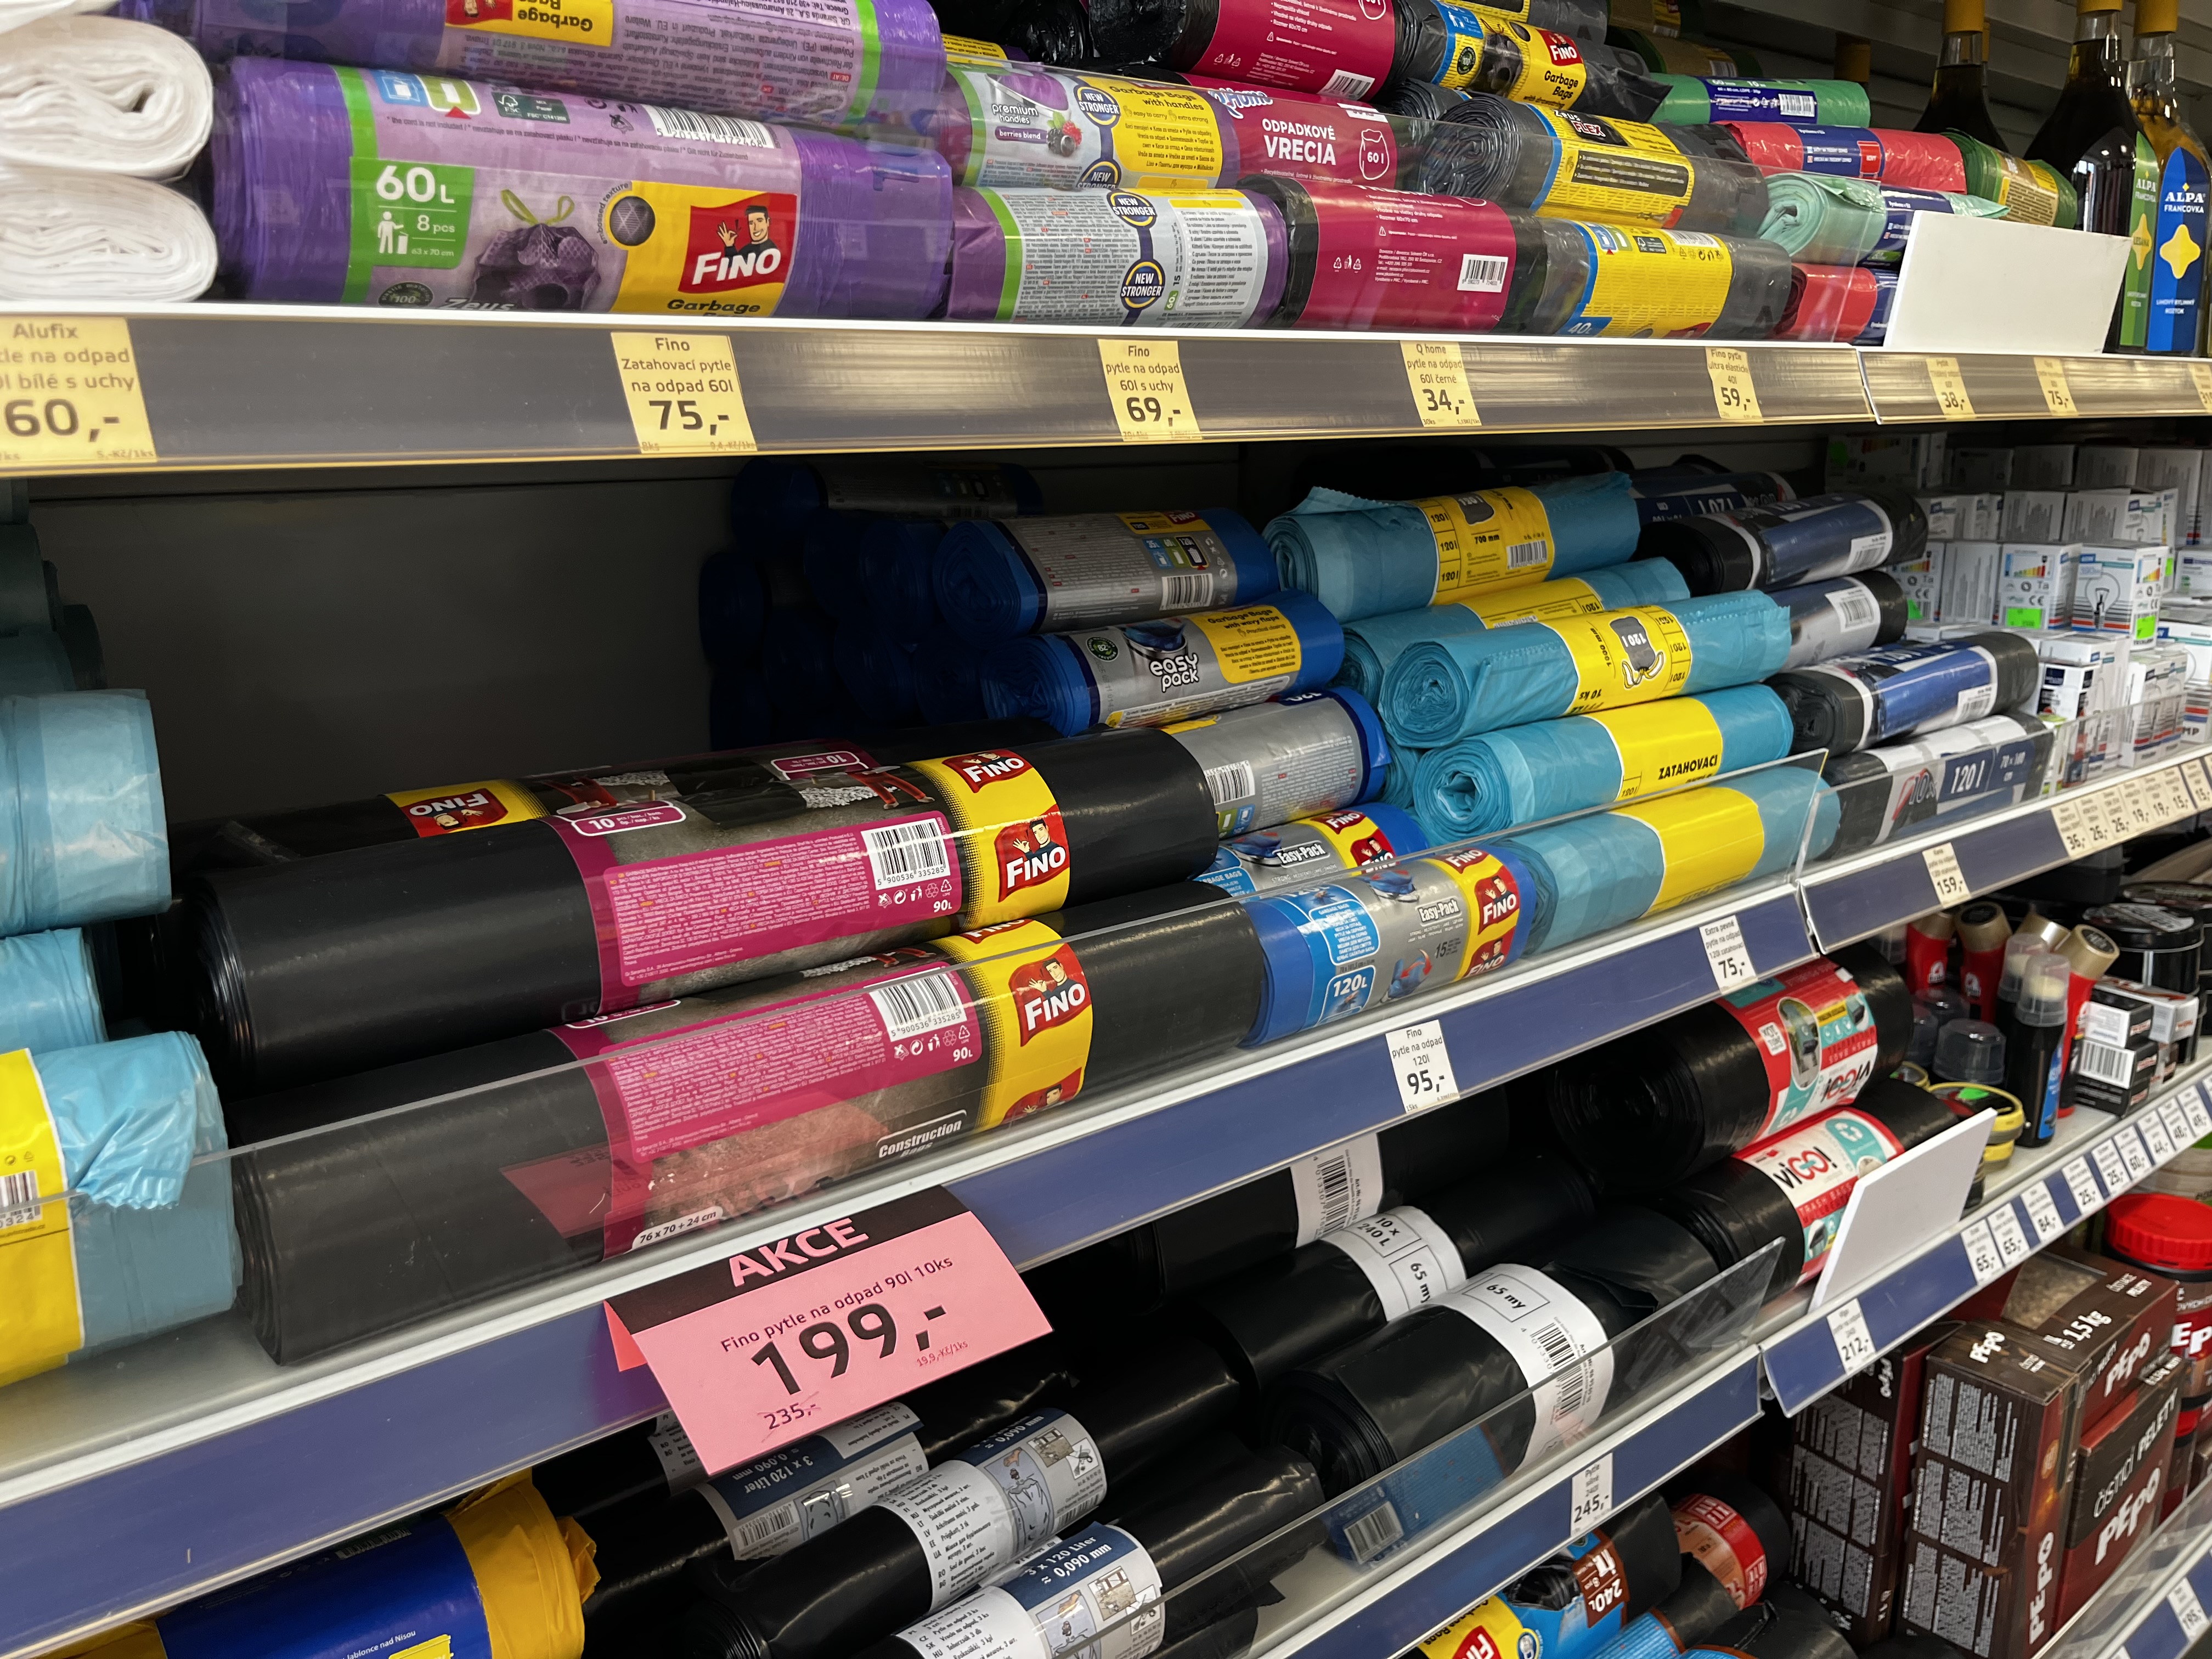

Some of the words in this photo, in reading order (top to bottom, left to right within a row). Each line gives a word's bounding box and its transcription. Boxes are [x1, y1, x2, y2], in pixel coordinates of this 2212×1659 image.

[517, 9, 592, 32] Garbage
[1550, 45, 1577, 60] FINO
[1545, 70, 1578, 89] Garbage
[1084, 92, 1104, 103] NEW
[1109, 86, 1165, 99] Garbage
[1167, 92, 1197, 102] Bags
[1553, 86, 1573, 100] Bags
[992, 103, 1039, 116] premium
[1079, 101, 1120, 115] STRONGER
[1142, 98, 1164, 107] with
[1166, 100, 1204, 110] handles
[999, 113, 1030, 125] handles
[999, 129, 1022, 138] berries
[1023, 131, 1041, 139] blend
[1262, 118, 1336, 141] ODPADKOVÉ
[1572, 121, 1606, 137] FLEX
[1263, 135, 1336, 166] VRECIA
[1367, 151, 1379, 163] 60
[1091, 171, 1111, 183] NEW
[2136, 178, 2157, 193] ALPA
[1117, 198, 1139, 206] NEW
[2165, 191, 2204, 204] ALPA
[1113, 206, 1156, 216] STRONGER
[2164, 204, 2205, 213] FRANCOVKA
[417, 215, 430, 231] 8
[433, 224, 455, 234] pcs
[692, 248, 781, 285] FINO
[1135, 273, 1154, 285] NEW
[1120, 285, 1163, 297] STRONGER
[439, 298, 515, 311] Zeus
[667, 299, 761, 314] Garbage
[13, 323, 78, 339] Alufix
[655, 337, 690, 352] Fino
[1128, 345, 1150, 357] Fino
[1416, 343, 1424, 356] Q
[1425, 343, 1447, 354] home
[1711, 349, 1726, 358] Fino
[30, 349, 56, 363] na
[64, 347, 130, 366] odpad
[622, 358, 696, 371] Zatahovací
[700, 360, 732, 374] pytle
[1407, 358, 1426, 370] pytle
[1439, 359, 1463, 370] odpad
[1708, 361, 1724, 370] ultra
[1105, 362, 1131, 375] pytle
[1133, 365, 1146, 374] na
[1148, 363, 1180, 376] odpad
[18, 373, 58, 390] bílé
[66, 377, 77, 389] s
[84, 373, 134, 392] uchy
[631, 381, 651, 392] na
[656, 379, 704, 395] odpad
[1141, 382, 1147, 391] s
[1149, 380, 1173, 394] uchy
[1435, 374, 1457, 384] černé
[1422, 388, 1465, 415] 34,-
[1720, 386, 1751, 411] 59,-
[648, 400, 730, 436] 75,-
[1126, 397, 1181, 427] 69,-
[1150, 653, 1199, 676] easy
[1161, 668, 1199, 693] pack
[963, 757, 1024, 783] FINO
[1951, 763, 1976, 794] 120
[410, 792, 489, 816] FINO
[589, 817, 616, 831] 10
[1325, 812, 1361, 829] FINO
[1277, 842, 1326, 865] Easy-Pack
[1447, 849, 1483, 867] FINO
[887, 873, 914, 884] 900536
[918, 866, 945, 878] 335285
[1006, 846, 1066, 889] FINO
[1224, 870, 1243, 879] BAGS
[1937, 877, 1963, 896] 159,-
[1419, 899, 1460, 923] Easy-Pack
[1483, 893, 1517, 926] FINO
[1435, 940, 1447, 959] 15
[1465, 954, 1504, 978] FINO
[1717, 956, 1746, 979] 75,-
[1333, 974, 1368, 998] 120L
[1024, 983, 1086, 1031] FINO
[901, 1020, 929, 1035] 900536
[933, 1012, 961, 1025] 335285
[1406, 1028, 1423, 1039] Fino
[1391, 1045, 1410, 1059] pytle
[1411, 1043, 1420, 1052] na
[1421, 1035, 1443, 1049] odpad
[1406, 1069, 1445, 1096] 95,-
[878, 1120, 962, 1159] Construction
[639, 1231, 654, 1244] 76
[654, 1230, 662, 1239] x
[663, 1223, 676, 1236] 70
[687, 1216, 701, 1228] 24
[701, 1210, 717, 1222] cm
[1356, 1222, 1384, 1238] 240
[1379, 1237, 1391, 1247] L
[1375, 1217, 1393, 1228] 10
[1389, 1228, 1401, 1237] x
[728, 1217, 870, 1288] AKCE
[1410, 1262, 1428, 1281] 65
[720, 1330, 760, 1353] Fino
[764, 1312, 808, 1339] pytle
[810, 1303, 832, 1319] na
[834, 1281, 884, 1311] odpad
[914, 1256, 954, 1279] 10ks
[1486, 1284, 1508, 1295] 65
[1504, 1294, 1526, 1310] my
[751, 1301, 946, 1396] 199,-
[1841, 1336, 1869, 1362] 212,-
[755, 1453, 788, 1472] 0,090
[803, 1455, 813, 1466] 3
[732, 1467, 754, 1482] mm
[770, 1464, 793, 1483] 120
[743, 1475, 771, 1494] Liter
[1573, 1493, 1610, 1524] 245,-
[1048, 1548, 1070, 1565] 120
[1069, 1534, 1098, 1553] Liter
[1053, 1554, 1090, 1578] 0,090
[1090, 1543, 1112, 1560] mm
[1588, 1578, 1623, 1613] 240L
[347, 1644, 379, 1659] Jablonce
[379, 1637, 394, 1649] nad
[394, 1630, 416, 1643] Nisou
